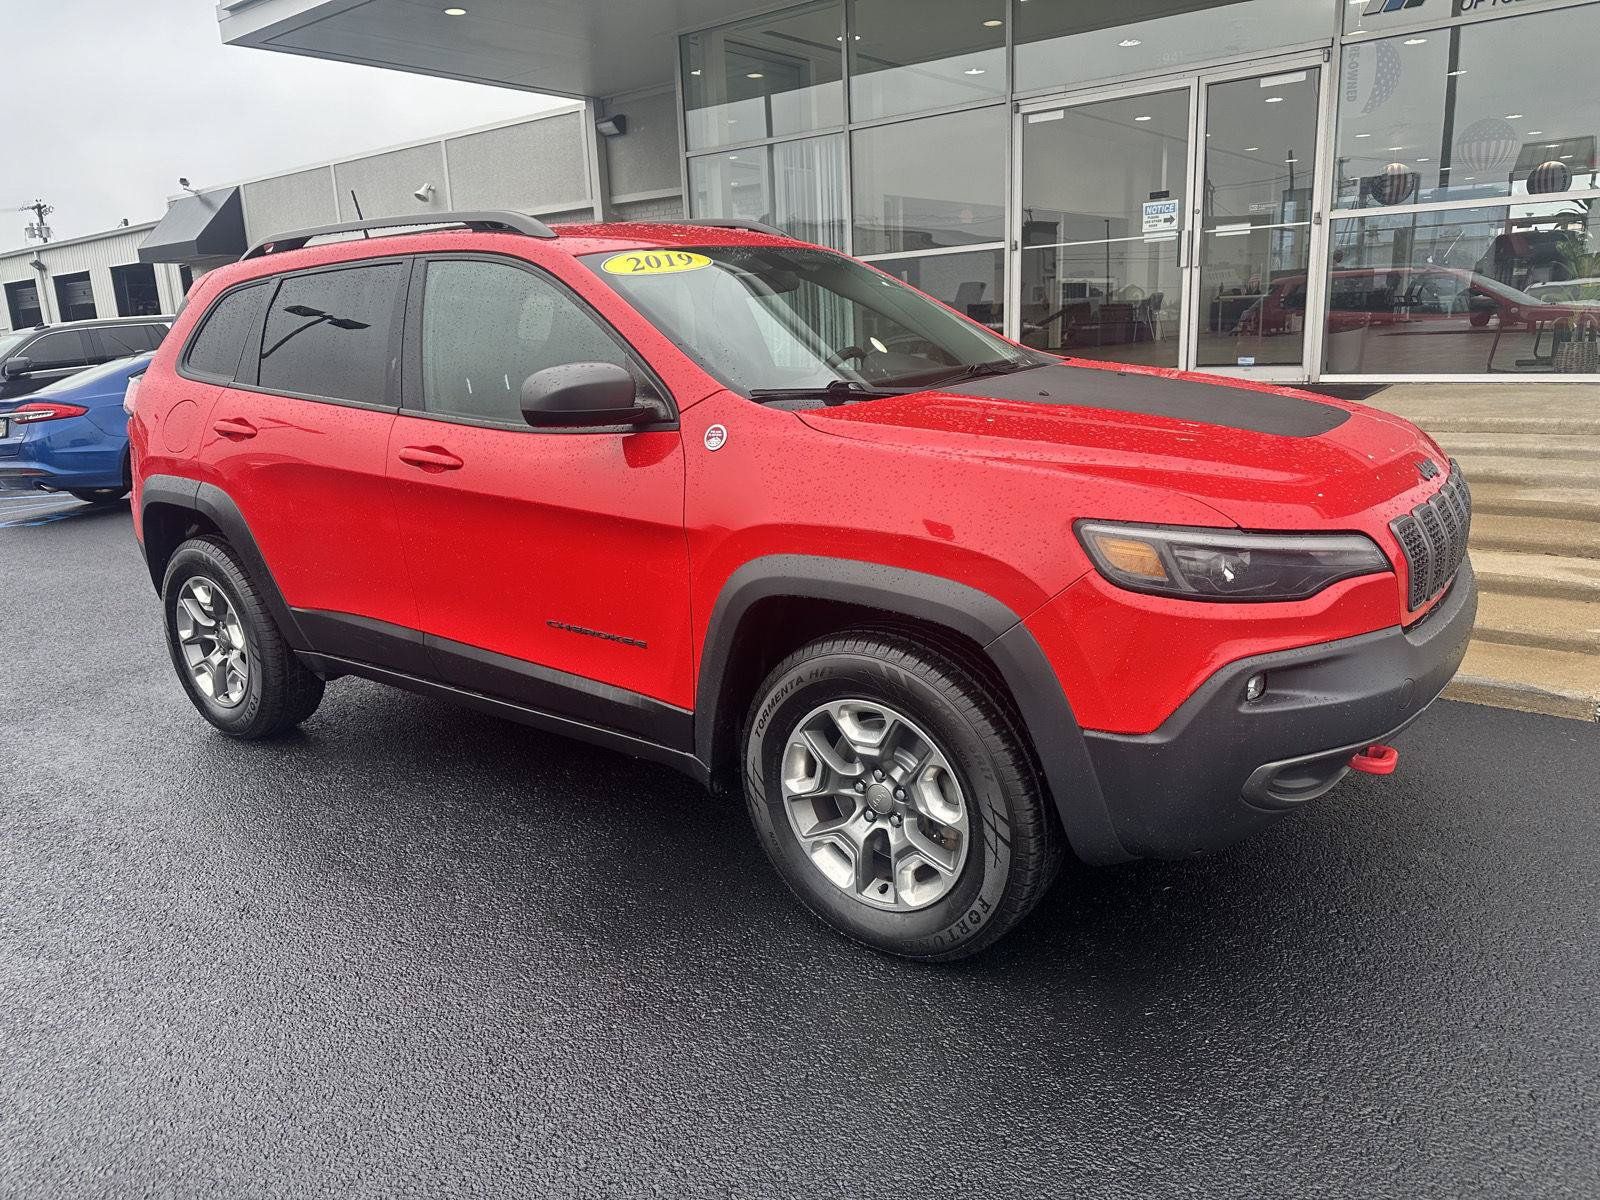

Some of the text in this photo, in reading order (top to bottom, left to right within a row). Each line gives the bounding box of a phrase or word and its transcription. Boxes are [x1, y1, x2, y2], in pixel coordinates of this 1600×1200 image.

[1146, 204, 1175, 215] NOTICE
[626, 253, 693, 272] 2019
[754, 676, 806, 738] TORMENTA
